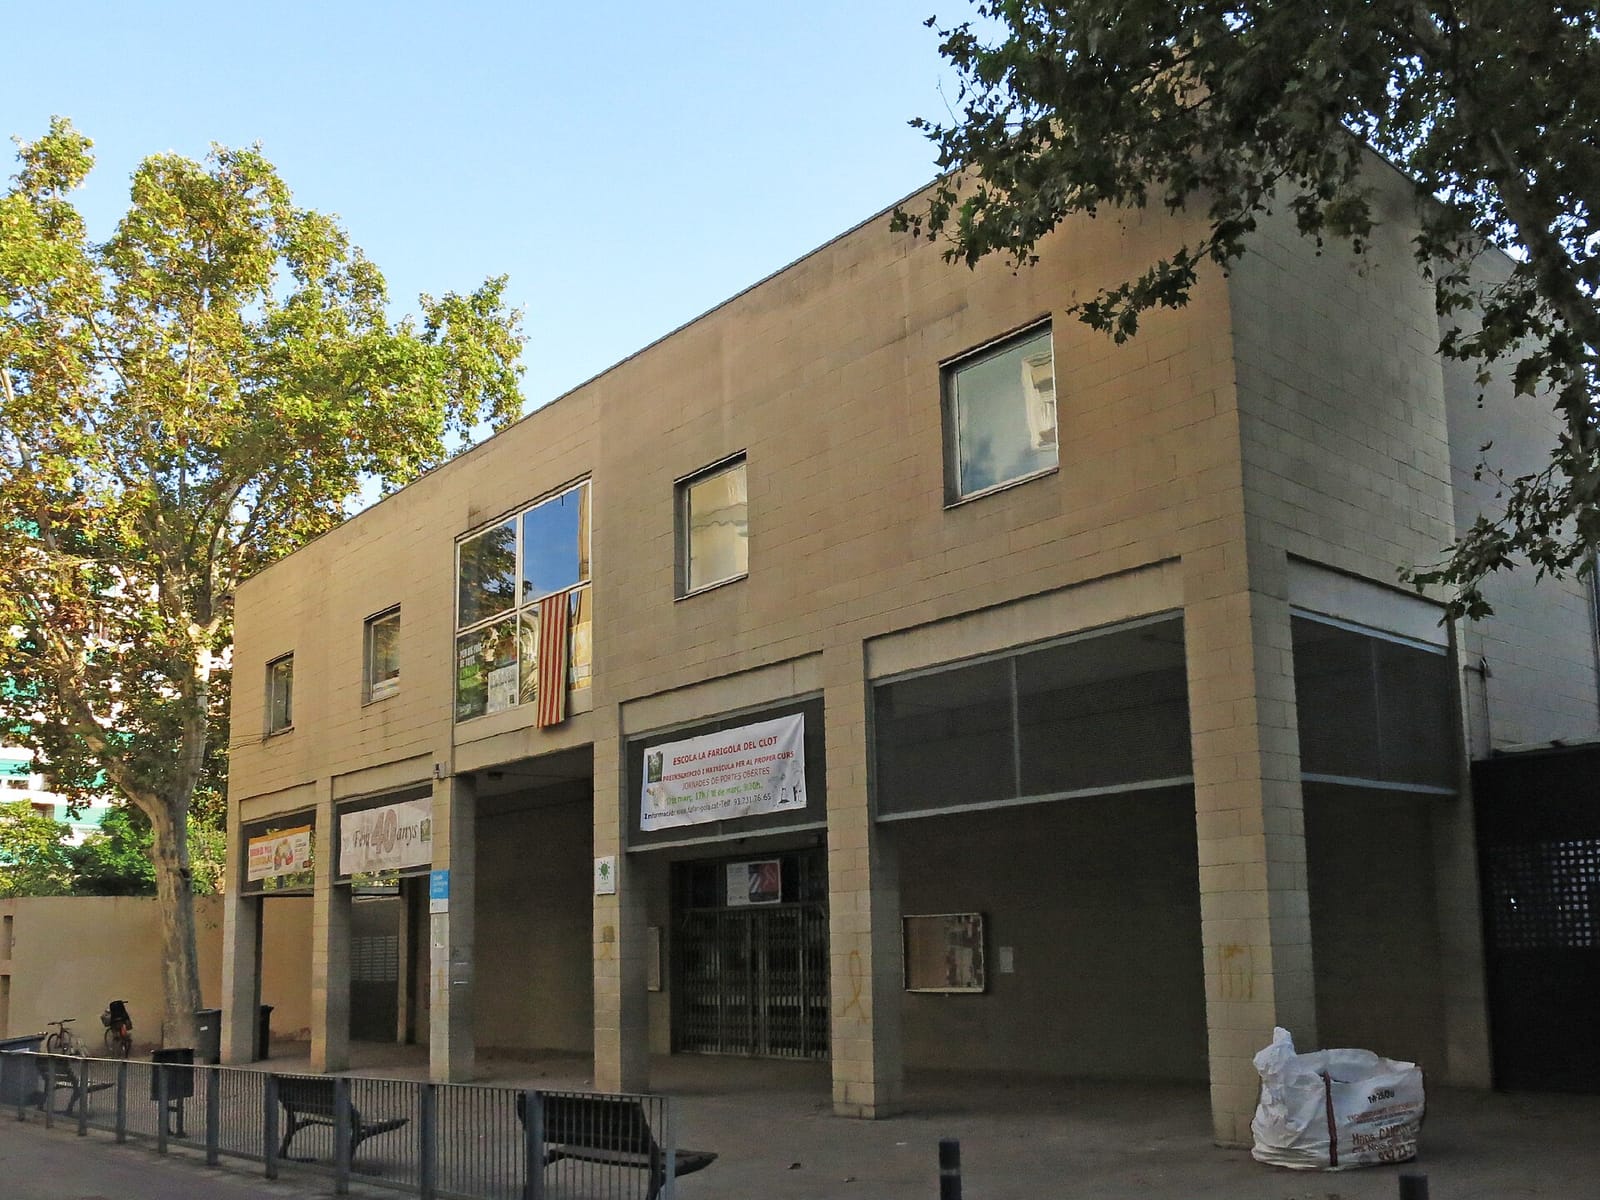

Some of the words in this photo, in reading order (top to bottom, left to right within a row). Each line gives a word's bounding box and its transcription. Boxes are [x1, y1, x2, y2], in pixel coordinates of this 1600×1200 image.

[673, 756, 697, 766] ESCOLA
[698, 751, 706, 759] LA
[707, 743, 742, 759] FARIGOLA
[743, 740, 757, 751] DEL
[758, 735, 778, 748] CLOT
[735, 759, 746, 768] PER
[746, 757, 754, 766] AL
[754, 753, 777, 765] PROPER
[777, 750, 795, 760] CURS
[682, 778, 710, 791] JORNADES
[720, 771, 742, 783] PORTES
[742, 766, 771, 779] OBERTES
[370, 809, 398, 855] 40
[397, 825, 418, 846] anys
